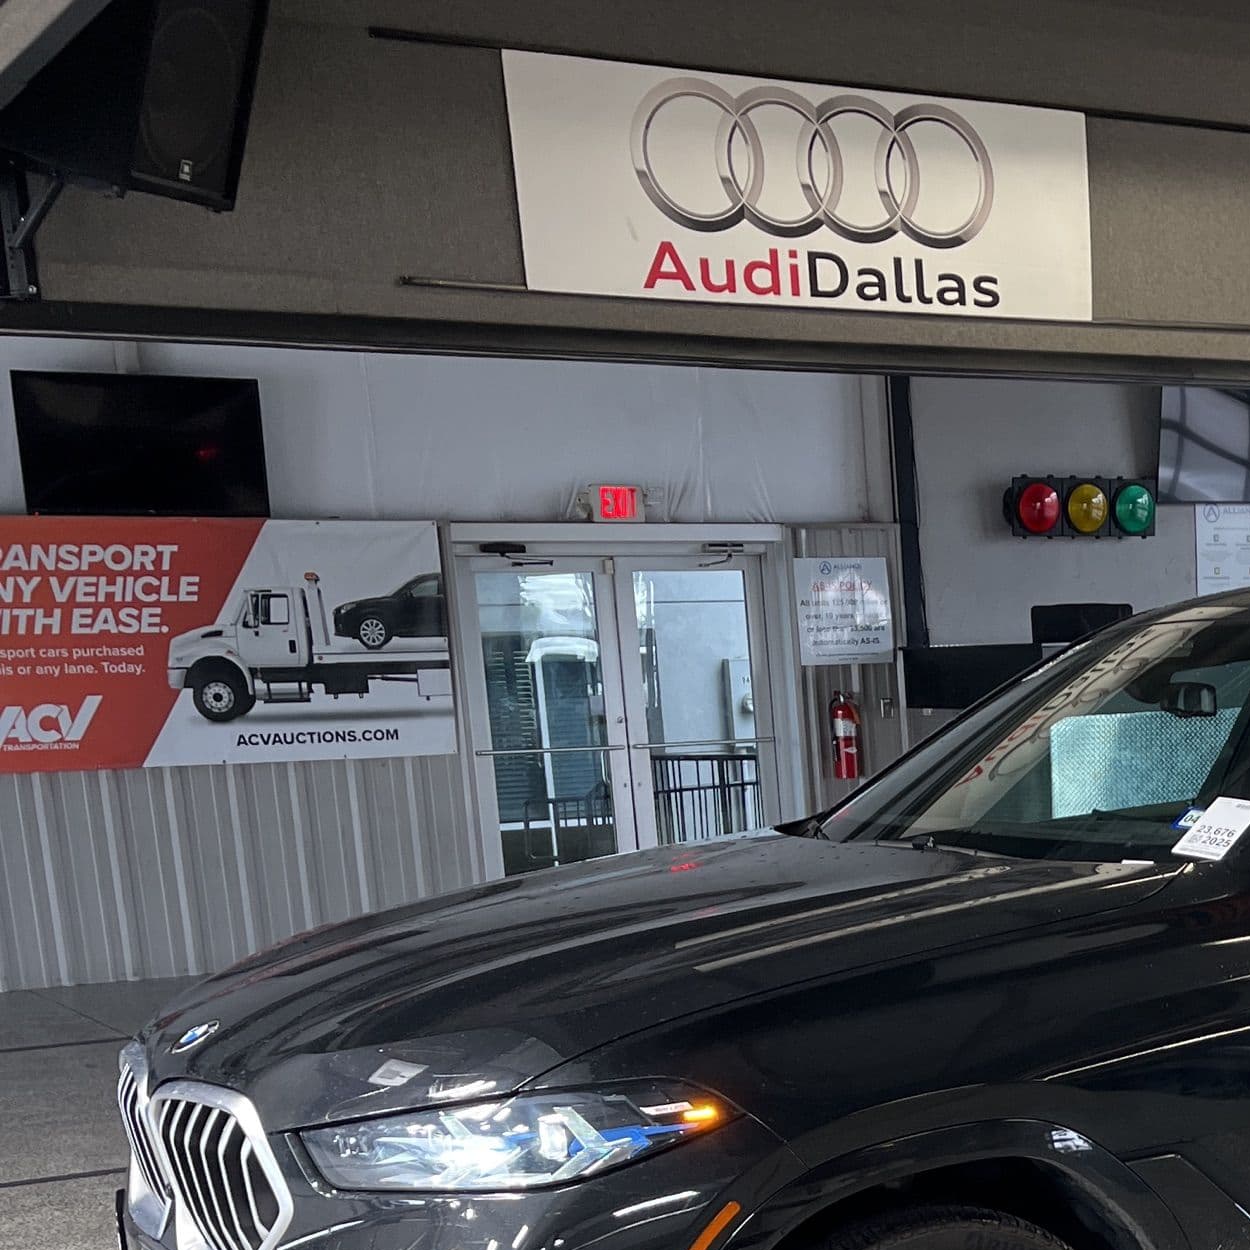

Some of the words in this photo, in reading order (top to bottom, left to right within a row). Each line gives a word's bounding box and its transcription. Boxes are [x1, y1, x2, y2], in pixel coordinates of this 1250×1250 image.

[643, 240, 1001, 308] AudiDallas
[0, 543, 178, 571] ANSPORT
[49, 576, 200, 602] VEHICLE
[0, 608, 62, 635] ITH
[71, 607, 169, 635] EASE.
[40, 647, 69, 658] cars
[73, 645, 145, 660] purchased
[17, 665, 31, 675] or
[36, 664, 60, 677] any
[64, 663, 98, 674] lane.
[101, 662, 145, 675] Today.
[0, 695, 103, 749] ACV
[3, 742, 80, 752] TRANSPORTATION
[236, 728, 399, 746] ACVAUCTIONS.COM
[1200, 835, 1232, 848] 2025
